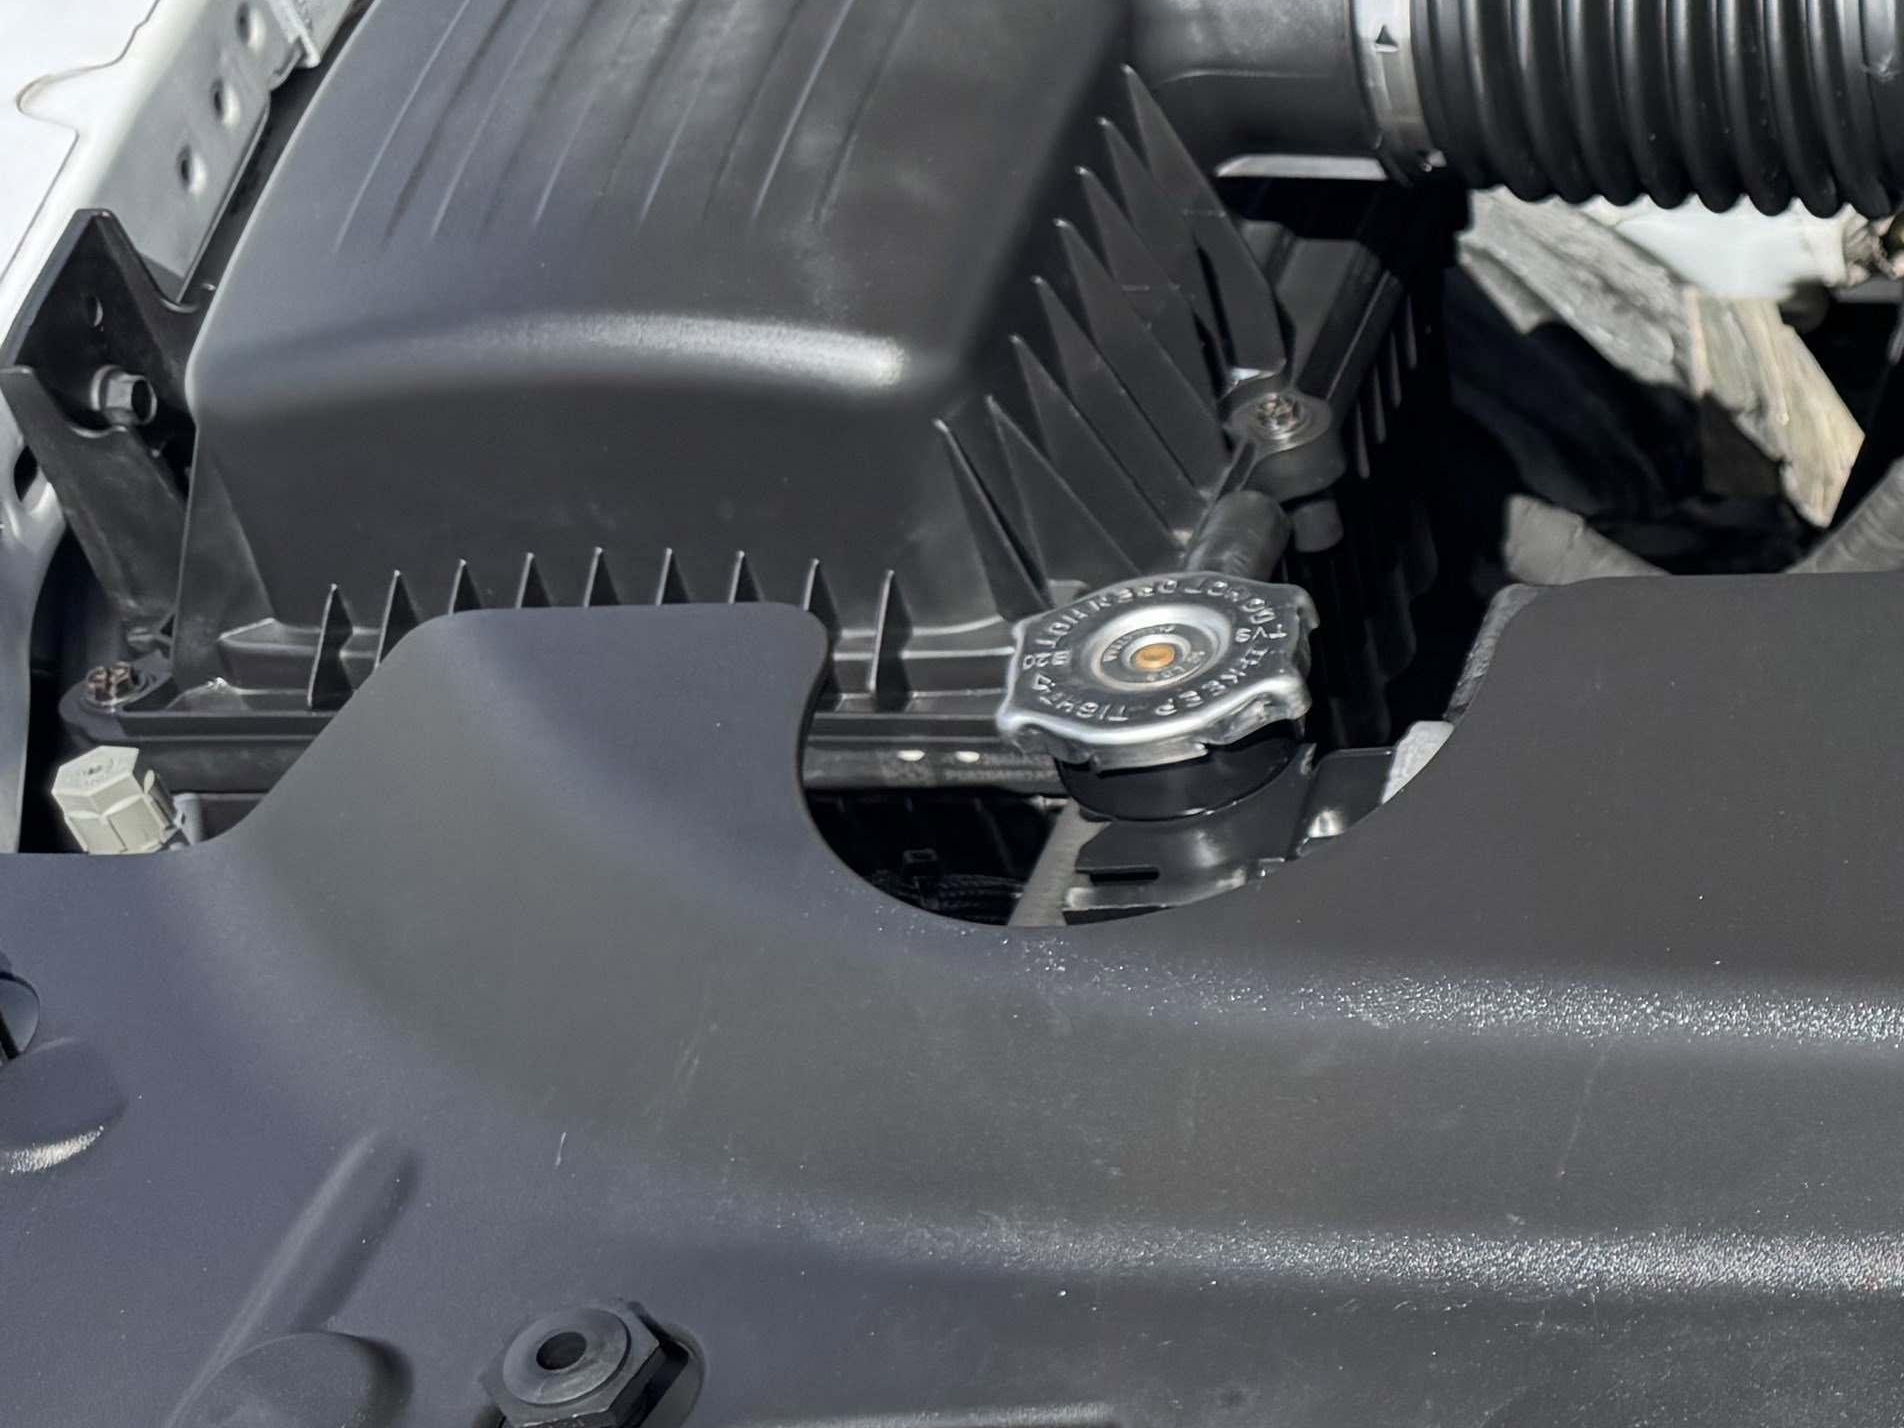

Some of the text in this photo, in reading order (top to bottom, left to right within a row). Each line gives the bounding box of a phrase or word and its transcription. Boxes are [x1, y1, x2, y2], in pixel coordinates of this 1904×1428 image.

[1234, 623, 1289, 643] TVS
[1038, 667, 1247, 723] KEEP TIGHT
